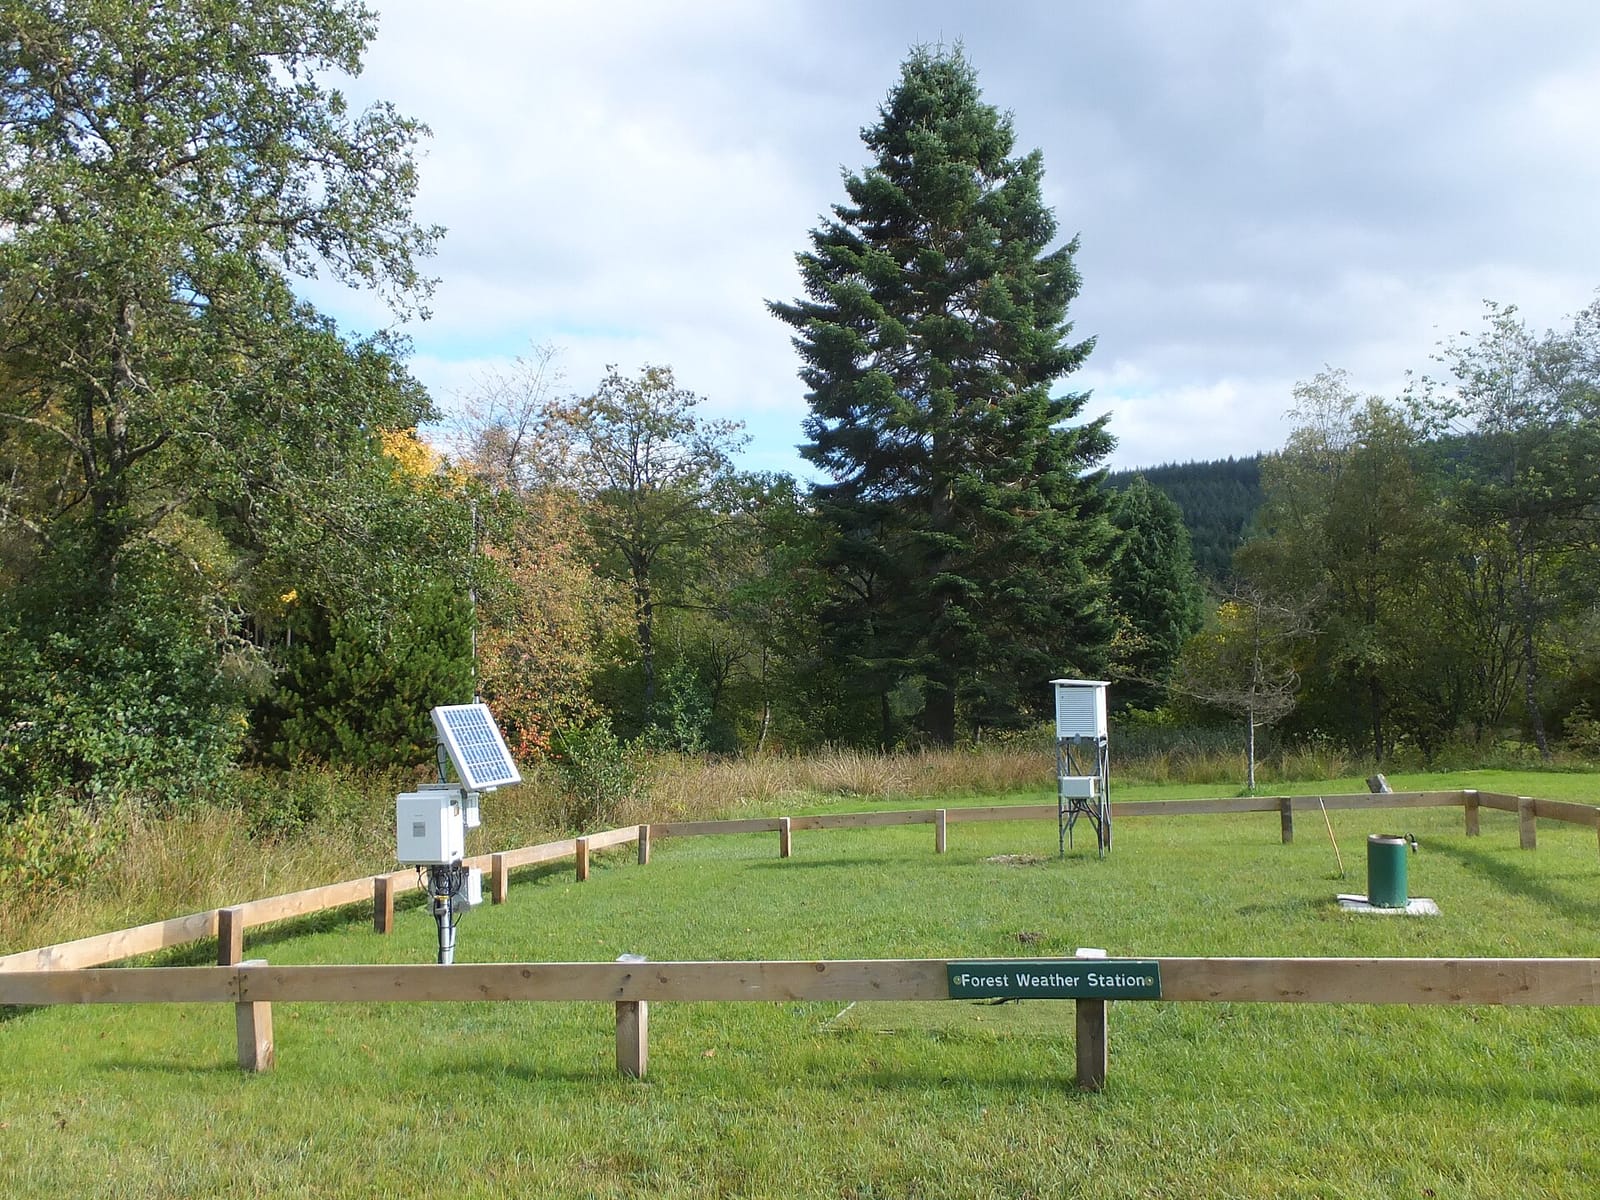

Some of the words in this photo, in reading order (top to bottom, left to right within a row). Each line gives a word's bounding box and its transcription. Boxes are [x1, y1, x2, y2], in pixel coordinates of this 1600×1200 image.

[961, 974, 1009, 987] Forest
[1016, 973, 1080, 987] Weather
[1087, 973, 1145, 987] Station
